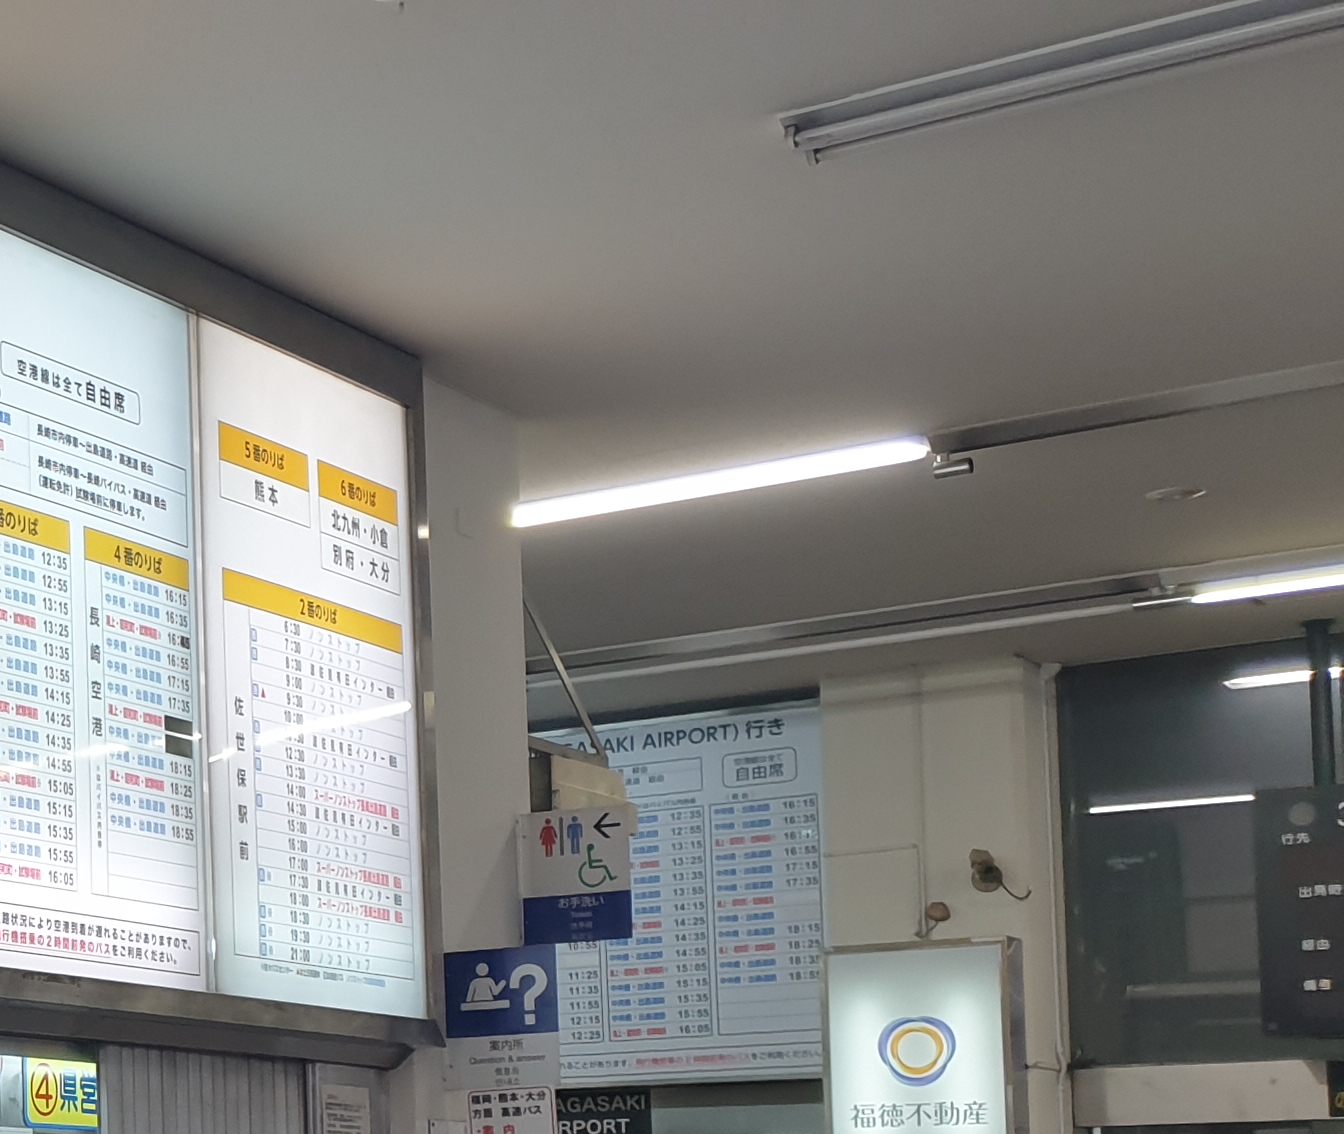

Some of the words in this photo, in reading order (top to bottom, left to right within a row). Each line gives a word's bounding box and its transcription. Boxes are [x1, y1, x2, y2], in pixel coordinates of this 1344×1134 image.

[16, 358, 125, 414] 空港線は全て自由席
[244, 440, 285, 472] 5番のりば
[254, 478, 280, 508] 熊本
[339, 478, 377, 508] 6番のりば
[330, 508, 389, 550] 北九州・小倉
[113, 544, 163, 576] 4番のりば
[331, 542, 391, 585] 別府・大分
[299, 598, 338, 625] 2番のりば
[89, 606, 104, 737] 長崎空港
[745, 718, 786, 740] 行き
[234, 696, 250, 861] 佐世保駅前
[736, 763, 785, 782] 自由席
[1281, 833, 1311, 845] 行先
[48, 868, 74, 887] 16:05
[557, 894, 605, 909] お手洗い
[469, 1056, 506, 1065] Question
[515, 1054, 547, 1062] answer
[488, 1040, 524, 1051] 案内所
[501, 1105, 543, 1117] 高速バス
[850, 1100, 989, 1130] 福徳不動産
